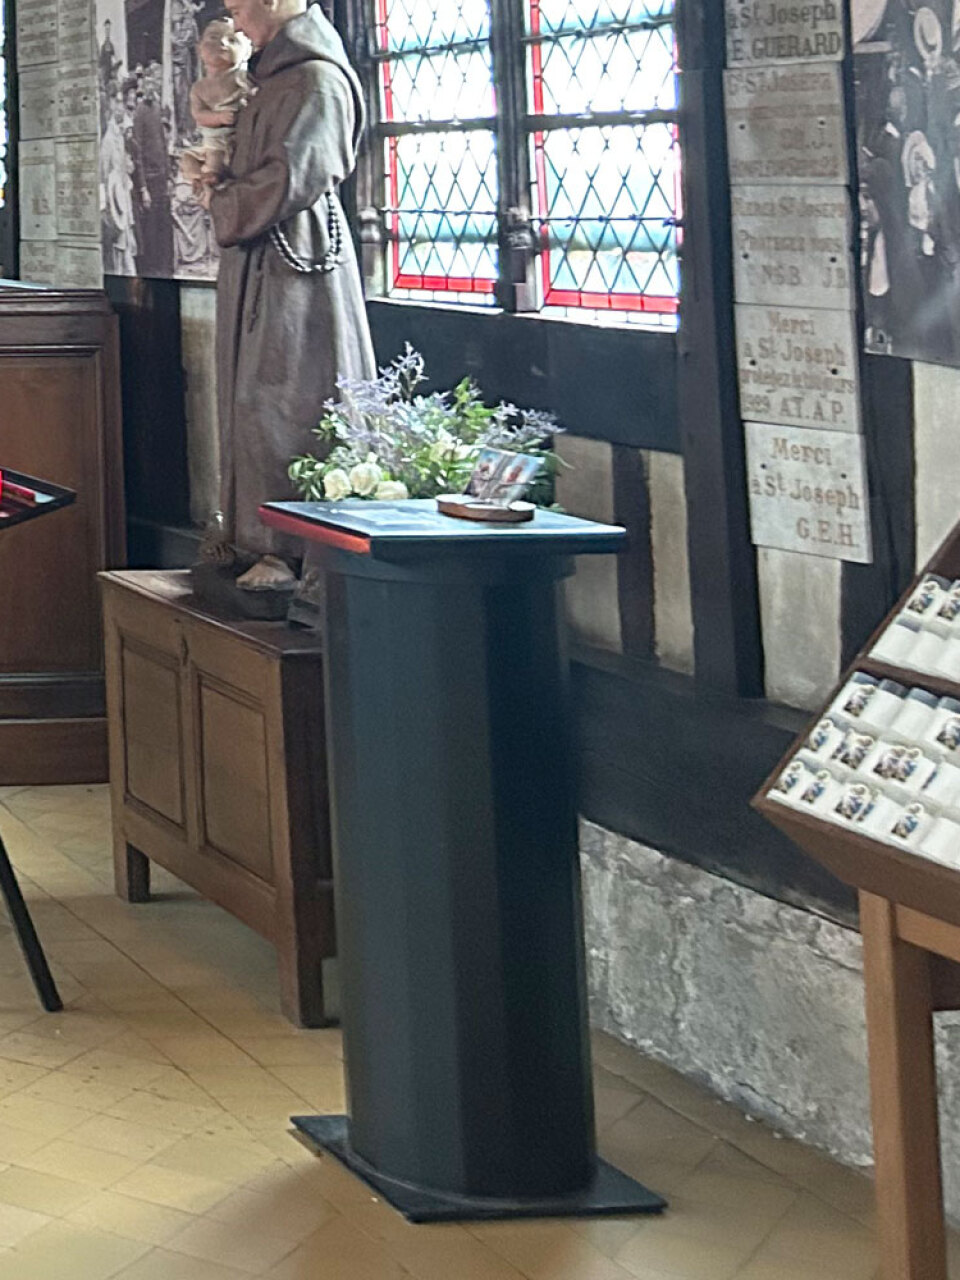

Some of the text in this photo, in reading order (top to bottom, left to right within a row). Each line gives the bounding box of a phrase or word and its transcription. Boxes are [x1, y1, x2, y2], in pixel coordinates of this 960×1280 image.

[767, 310, 815, 336] Merci
[780, 337, 847, 369] Joseph
[770, 437, 833, 467] Merci
[789, 478, 860, 516] Joseph
